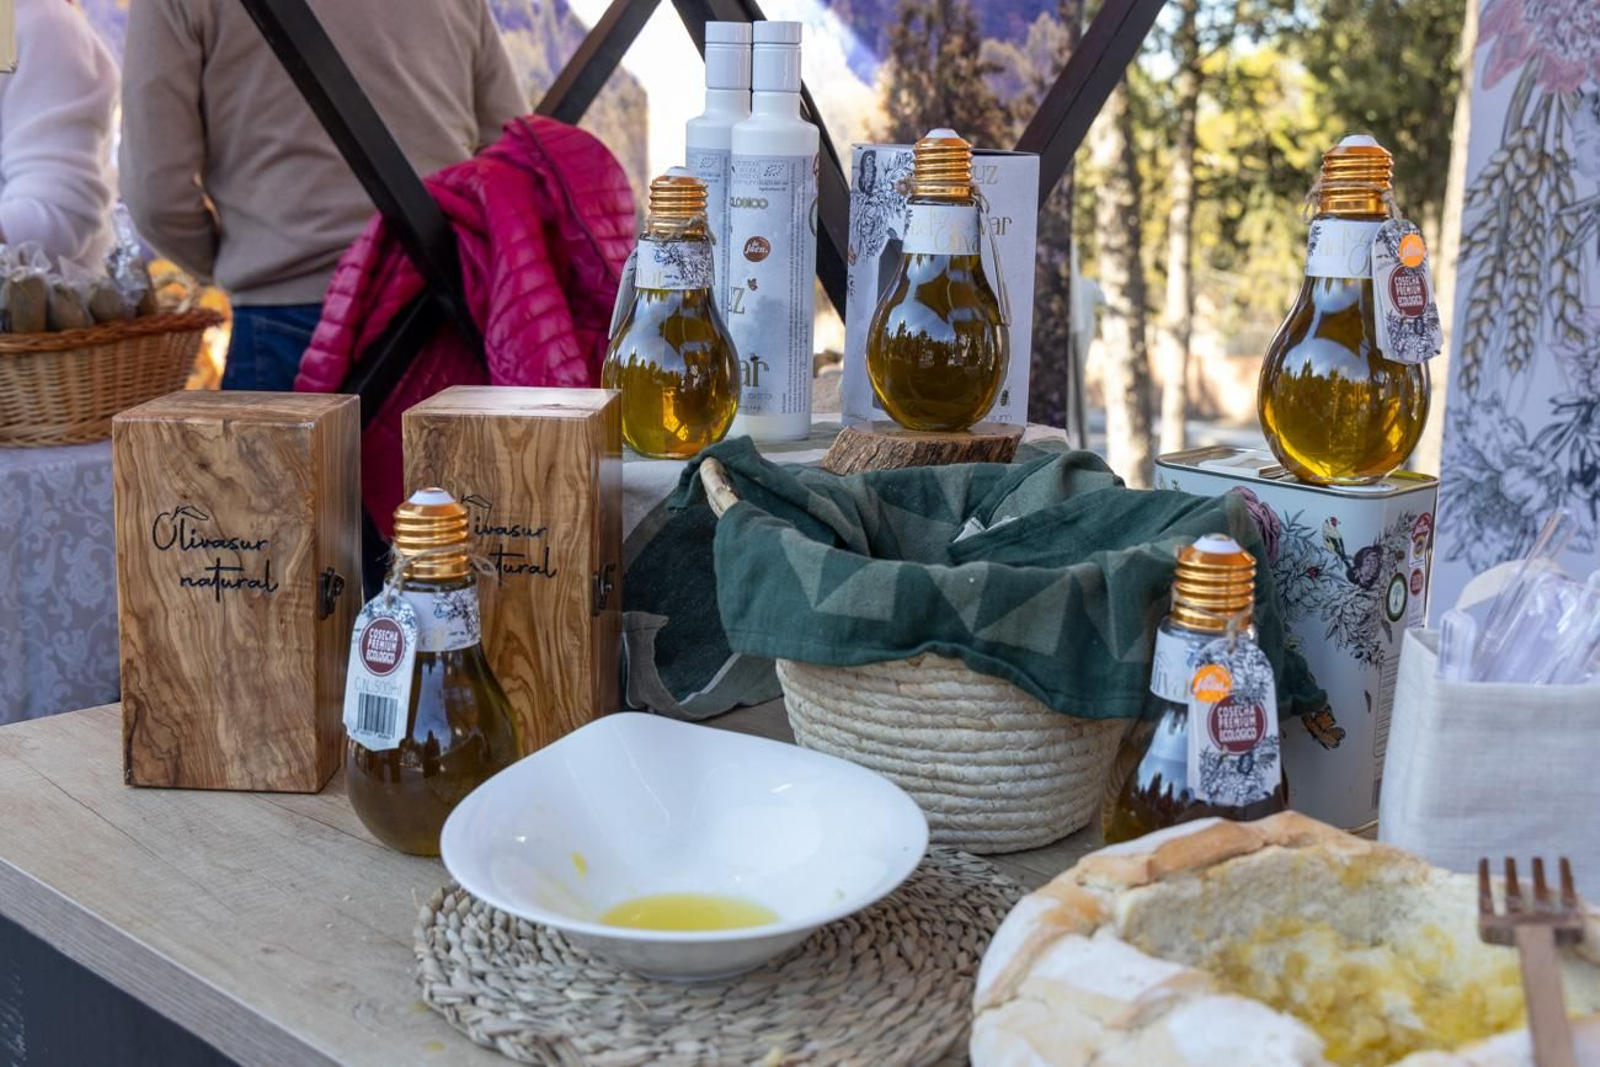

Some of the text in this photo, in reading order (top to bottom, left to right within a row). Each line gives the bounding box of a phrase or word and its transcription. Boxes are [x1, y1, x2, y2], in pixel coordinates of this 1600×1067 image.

[152, 506, 270, 552] Olivasur
[474, 516, 547, 537] ivasur
[180, 557, 279, 602] natural
[368, 628, 399, 642] COSECHA
[367, 639, 398, 653] PREMIUM
[1217, 704, 1256, 717] COSECHA
[1217, 716, 1257, 729] PREMIUM
